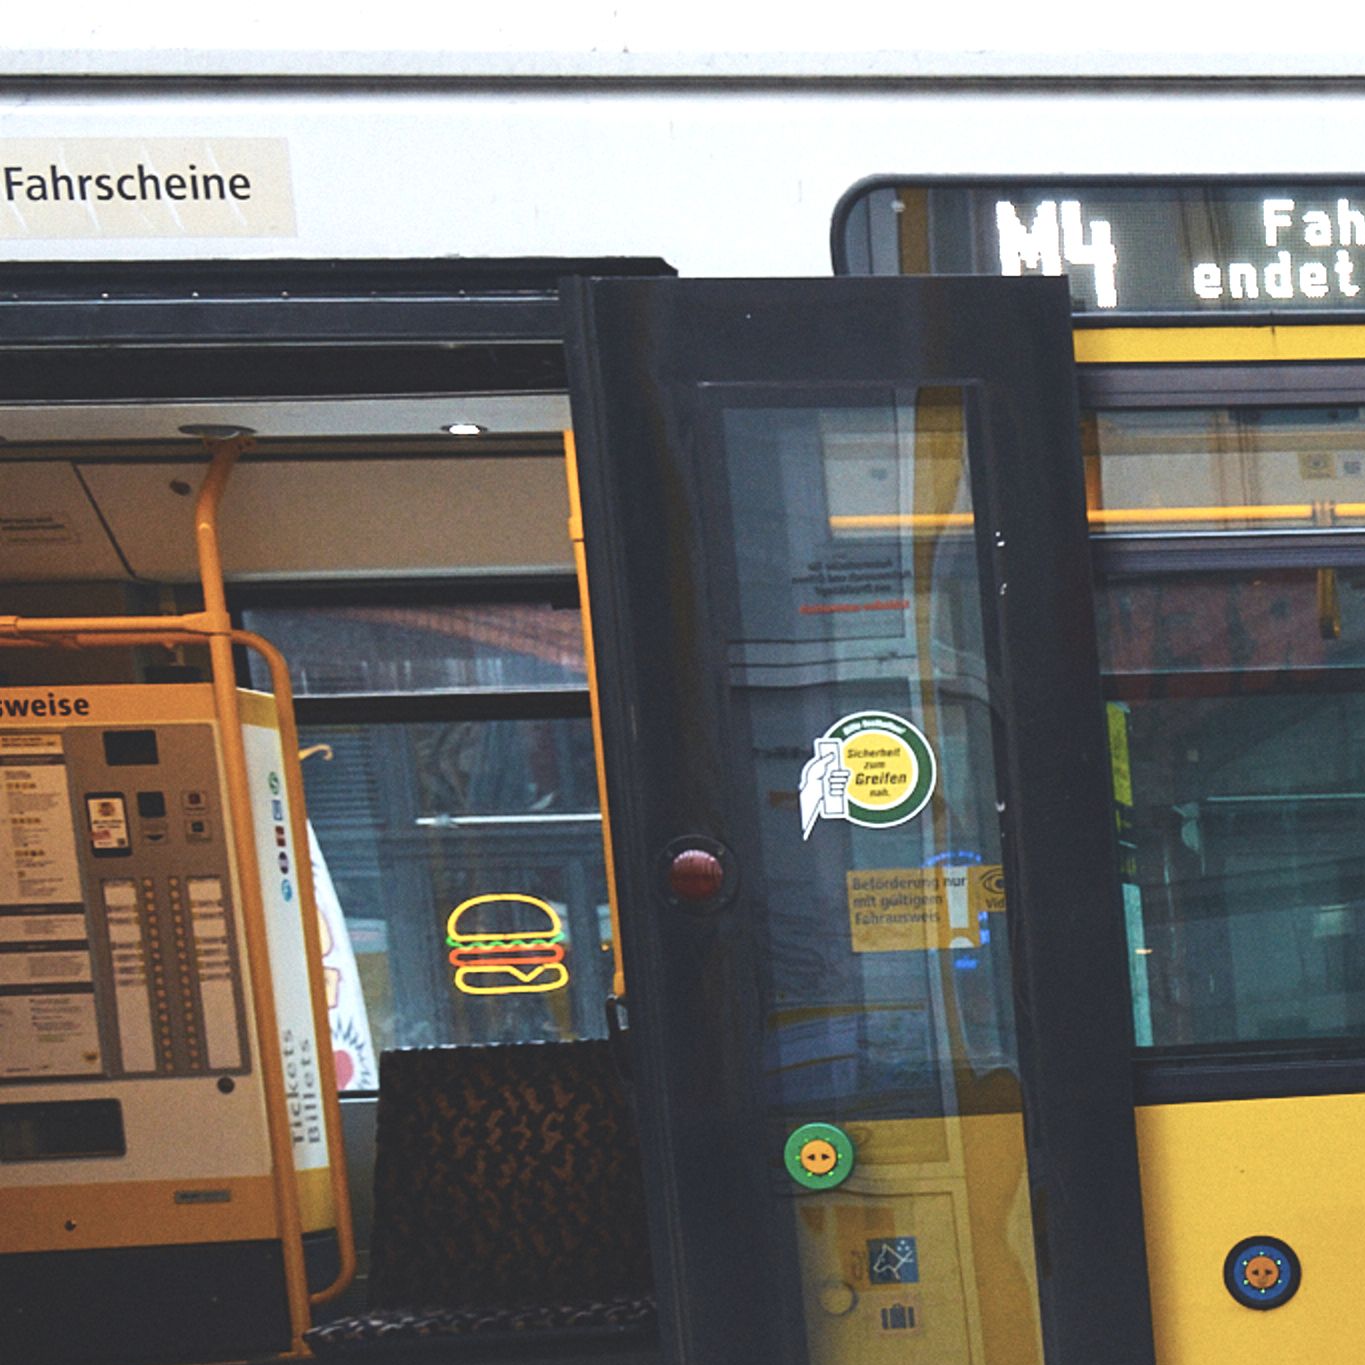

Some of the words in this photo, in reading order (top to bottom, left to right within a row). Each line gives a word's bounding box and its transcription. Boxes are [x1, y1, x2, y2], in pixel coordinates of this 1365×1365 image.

[3, 165, 251, 201] Fahrscheine
[996, 200, 1117, 308] M4
[1193, 250, 1360, 298] endet
[848, 748, 901, 759] Sicherheit
[863, 762, 886, 770] zum
[855, 772, 907, 786] Greifen
[944, 877, 967, 887] nur
[852, 896, 876, 908] mit
[881, 893, 943, 910] gültigem
[854, 911, 941, 925] Fahrausweis
[284, 1029, 304, 1144] Tickets
[300, 1038, 321, 1144] Billets
